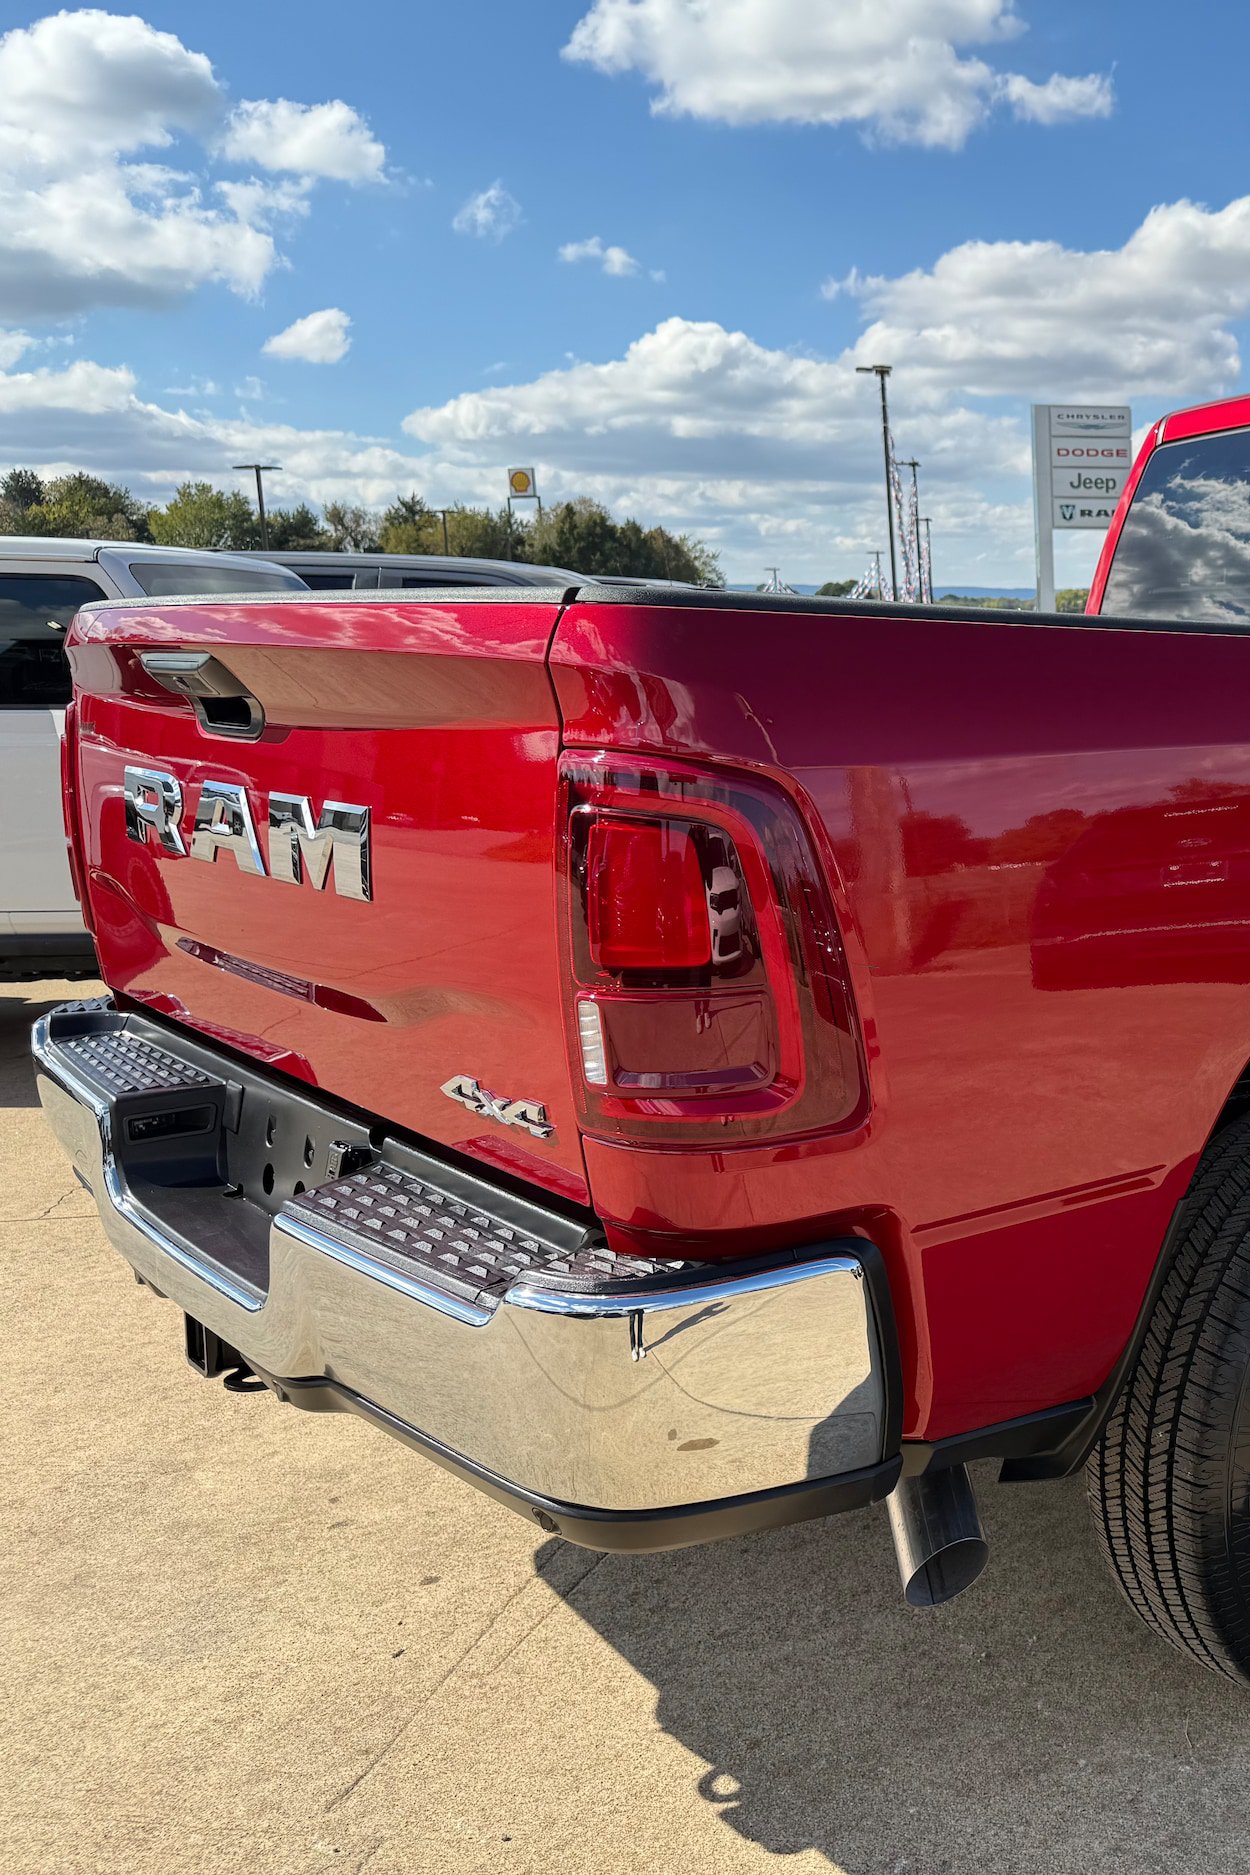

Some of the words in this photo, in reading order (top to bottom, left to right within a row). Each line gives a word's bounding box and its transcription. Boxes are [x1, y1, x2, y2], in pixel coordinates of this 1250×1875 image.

[1057, 447, 1128, 458] DODGE
[1069, 473, 1117, 493] Jeep
[124, 765, 374, 903] RAM
